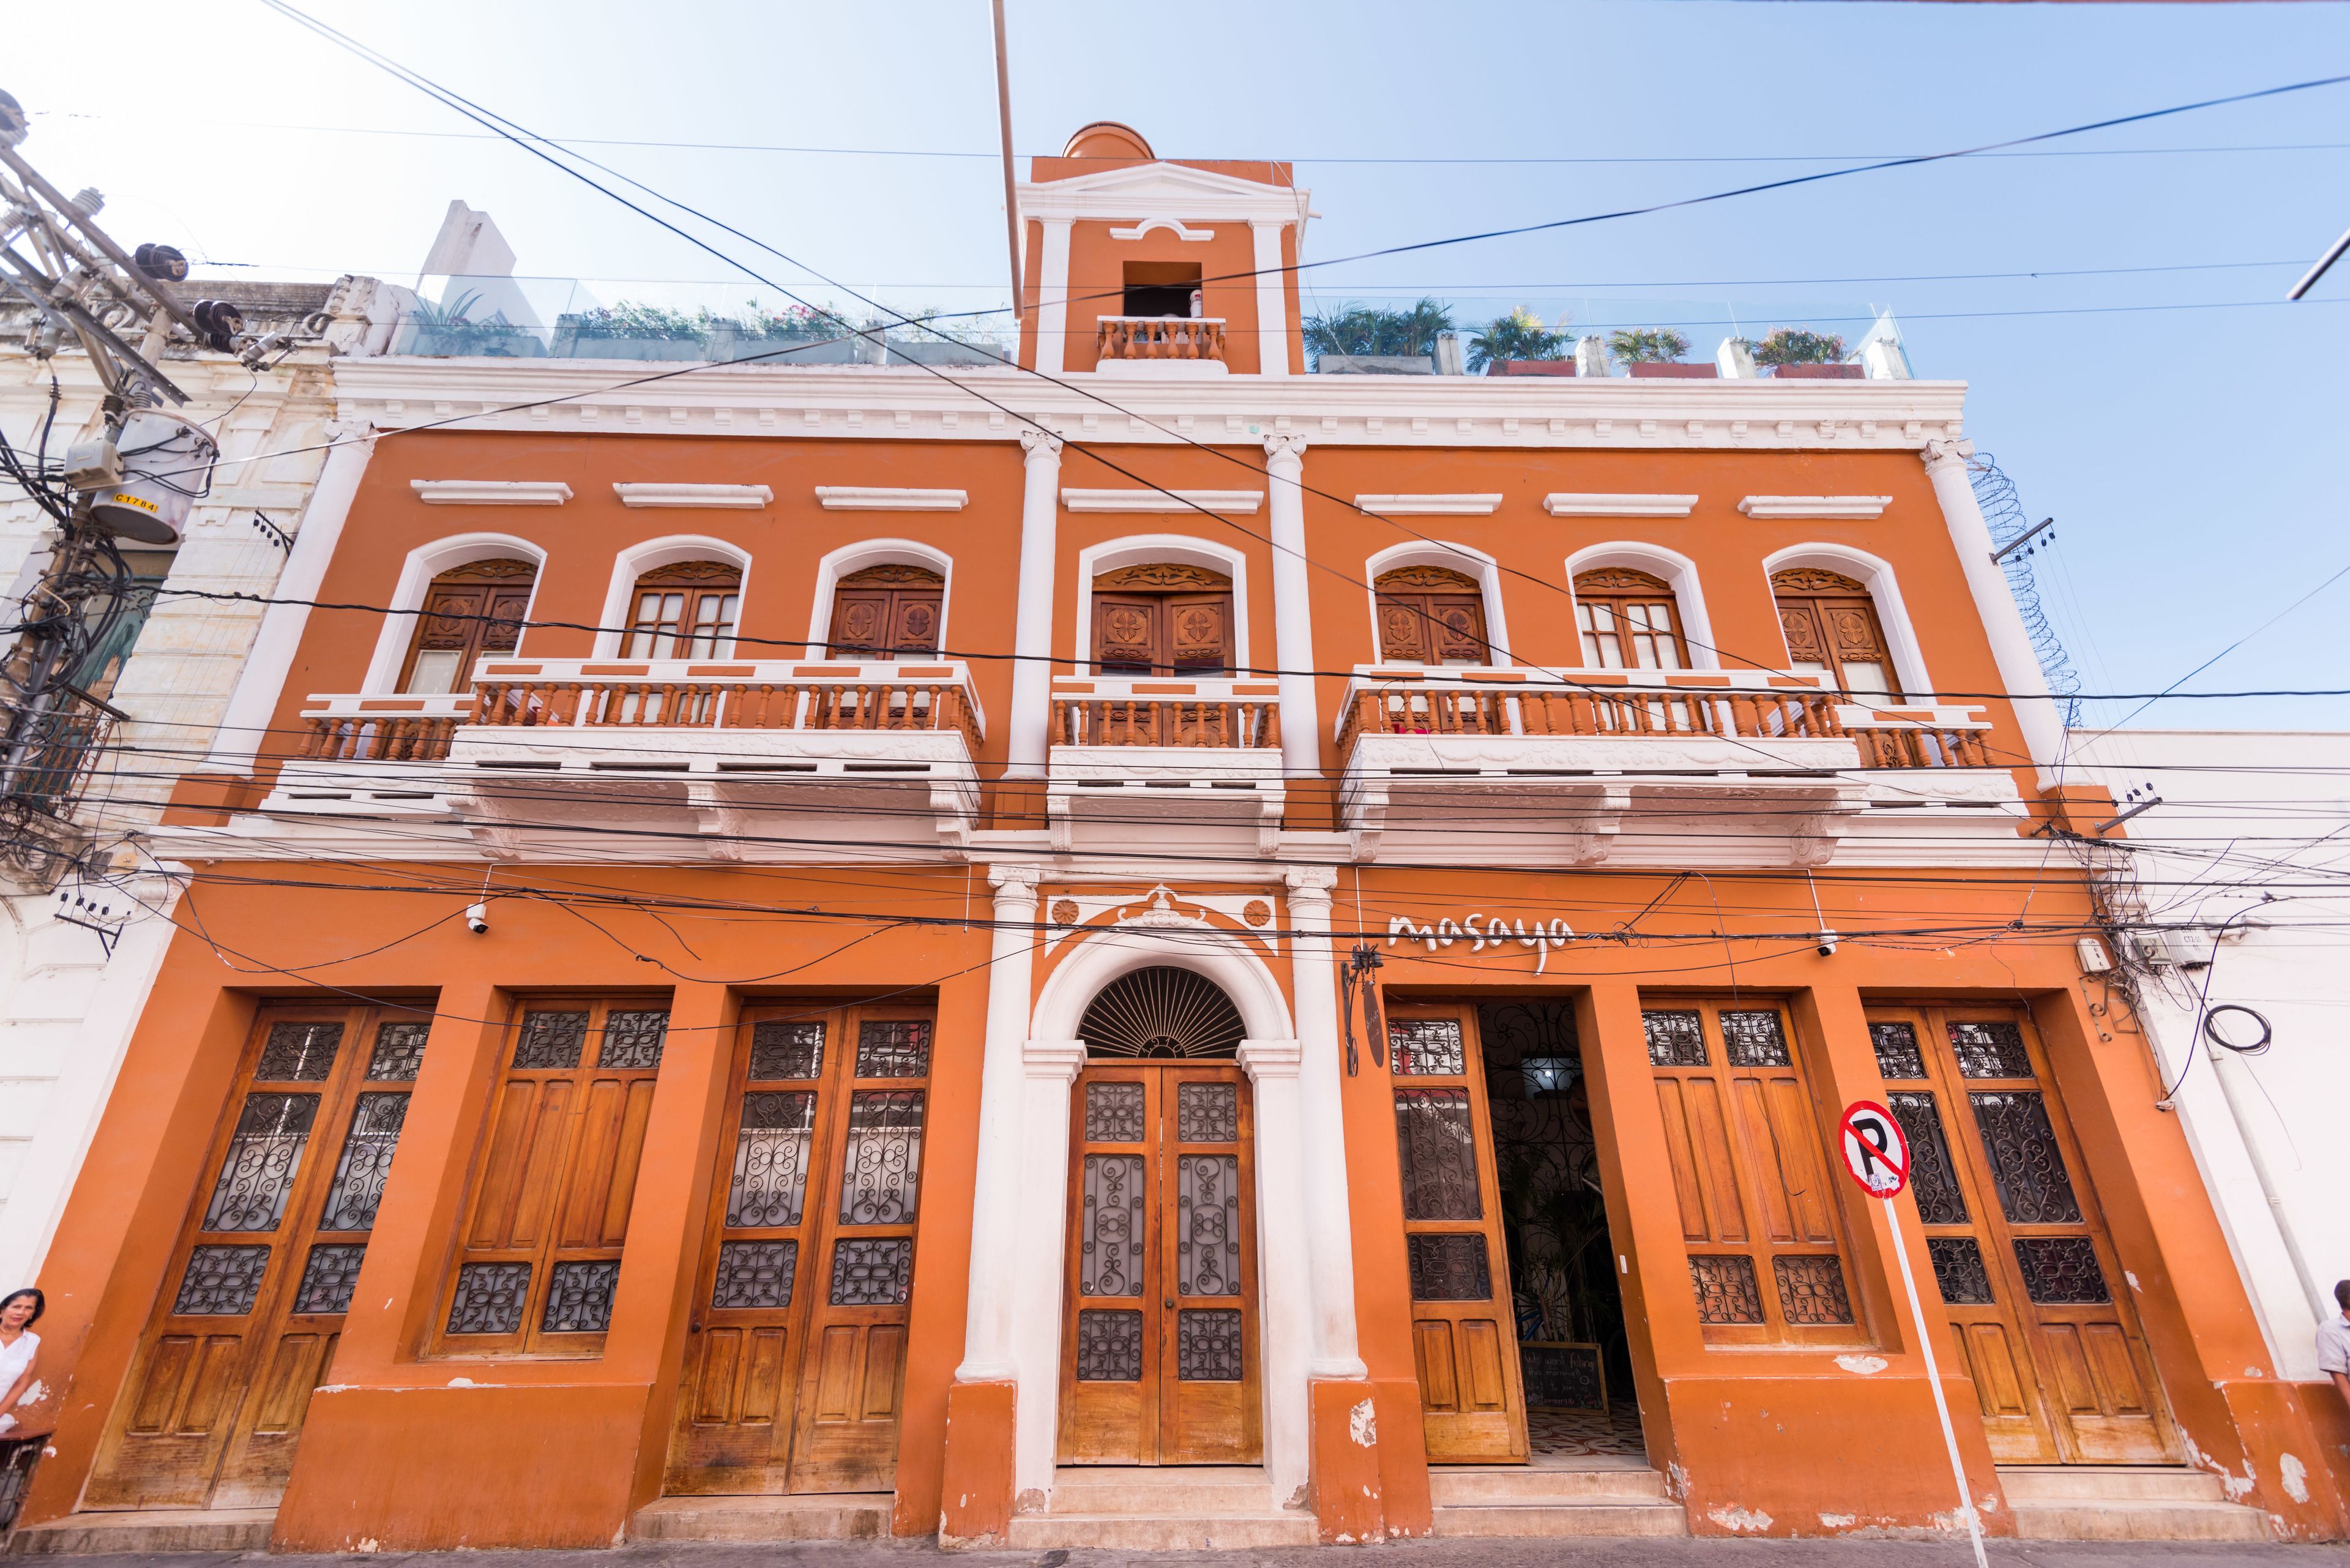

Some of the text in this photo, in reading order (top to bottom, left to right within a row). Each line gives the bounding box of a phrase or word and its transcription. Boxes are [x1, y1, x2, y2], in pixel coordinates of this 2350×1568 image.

[116, 494, 154, 510] C1784
[1387, 913, 1576, 977] masaya
[1545, 1351, 1565, 1366] went
[1550, 1379, 1557, 1391] to
